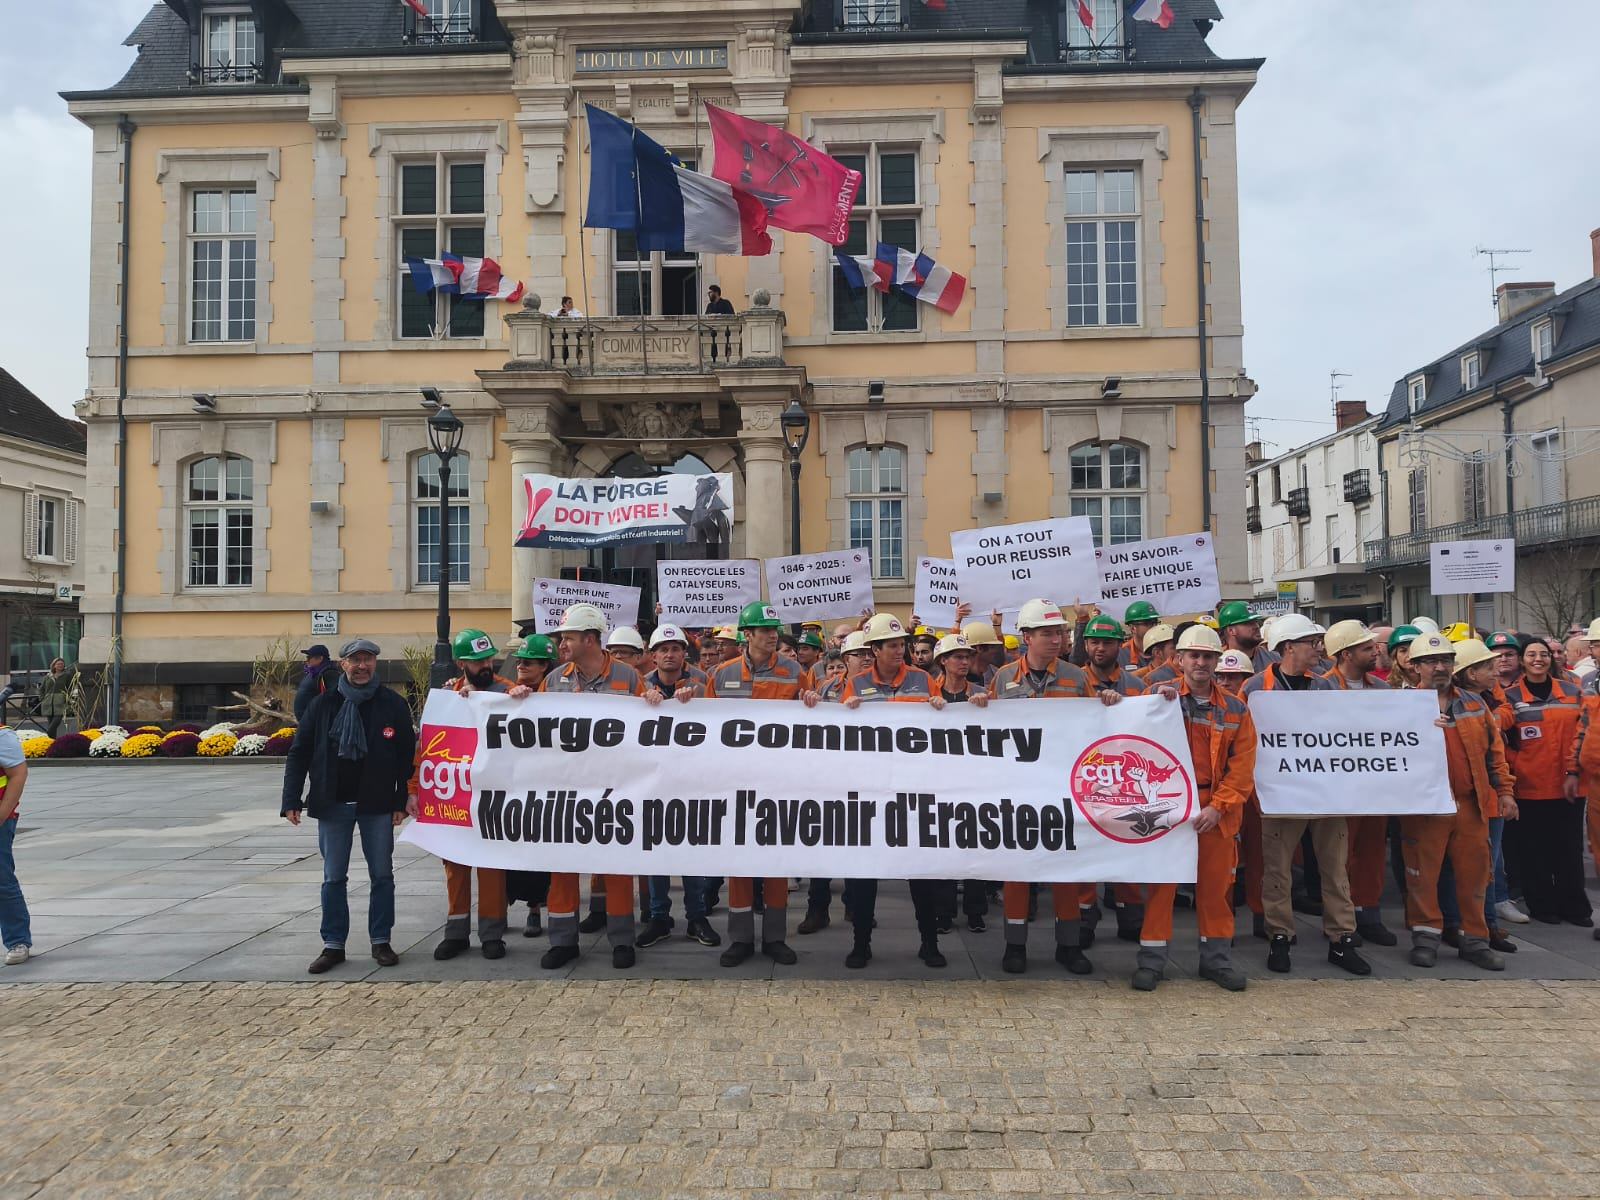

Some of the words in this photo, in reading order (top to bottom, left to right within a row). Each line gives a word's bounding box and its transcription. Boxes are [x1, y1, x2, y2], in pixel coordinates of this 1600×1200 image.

[645, 51, 667, 67] DE
[671, 49, 721, 66] VILLE
[601, 337, 690, 353] COMMENTRY
[556, 482, 588, 502] LA
[593, 480, 669, 504] FORGE
[554, 506, 605, 526] DOIT
[607, 504, 659, 526] VIVRE
[979, 536, 1001, 549] ON
[1004, 535, 1014, 546] A
[1016, 530, 1053, 545] TOUT
[966, 553, 1007, 567] POUR
[1010, 546, 1072, 563] REUSSIR
[1109, 553, 1128, 564] UN
[1132, 546, 1183, 561] SAVOIR-
[664, 567, 679, 576] ON
[681, 567, 726, 576] RECYCLE
[727, 567, 745, 576] LES
[781, 563, 805, 574] 1846
[815, 559, 840, 570] 2025
[929, 566, 947, 576] ON
[1011, 568, 1031, 580] ICI
[1104, 568, 1141, 582] FAIRE
[1143, 561, 1194, 577] UNIQUE
[668, 580, 741, 589] CATALYSEURS,
[778, 581, 794, 591] ON
[796, 575, 852, 589] CONTINUE
[1101, 588, 1119, 600] NE
[1121, 586, 1137, 597] SE
[1140, 581, 1174, 595] JETTE
[1177, 577, 1202, 590] PAS
[555, 587, 590, 597] FERMER
[591, 589, 610, 599] UNE
[685, 593, 705, 601] PAS
[706, 593, 724, 601] LES
[782, 591, 852, 607] L'AVENTURE
[929, 594, 947, 604] ON
[542, 597, 574, 606] FILIERE
[667, 605, 738, 614] TRAVAILLEURS
[486, 713, 626, 752] Forge
[638, 715, 707, 747] de
[720, 718, 1043, 763] Commentry
[1260, 733, 1287, 748] NE
[1292, 732, 1375, 748] TOUCHE
[1380, 731, 1420, 747] PAS
[1278, 757, 1292, 773] A
[1296, 758, 1326, 773] MA
[1330, 757, 1398, 773] FORGE
[1402, 757, 1409, 772] !
[419, 754, 472, 800] cgt
[1081, 760, 1125, 787] cgt
[1083, 795, 1137, 804] ERASTEEL
[424, 802, 435, 817] de
[438, 803, 469, 821] l'Allier
[477, 788, 634, 845] Mobilisés
[642, 798, 727, 851] pour
[734, 789, 877, 847] l'avenir
[885, 792, 1077, 851] d'Erasteel
